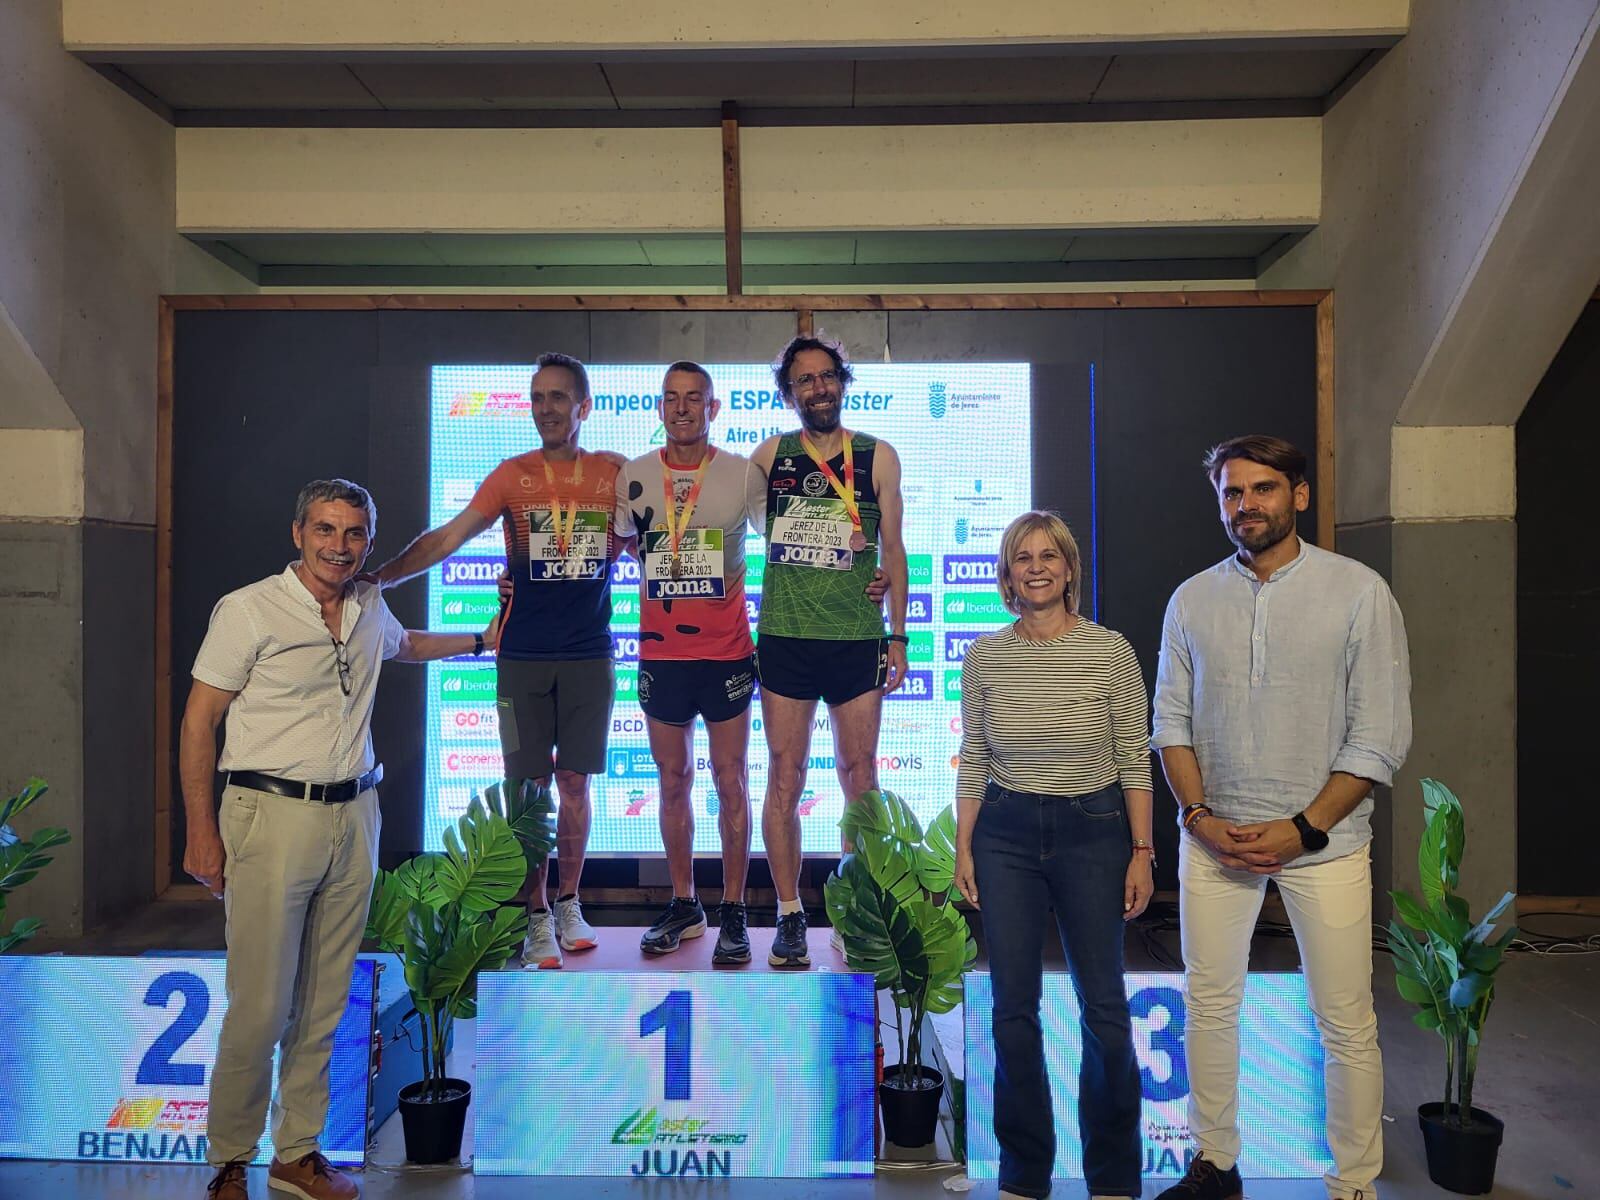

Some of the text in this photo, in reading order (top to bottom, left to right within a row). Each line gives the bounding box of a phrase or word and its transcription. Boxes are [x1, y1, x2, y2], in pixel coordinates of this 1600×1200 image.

[730, 390, 784, 410] ESPA
[727, 427, 758, 443] Aire
[790, 521, 838, 534] JEREZ DE LA
[573, 534, 583, 545] DE
[783, 532, 842, 547] FRONTERA 2023
[585, 546, 599, 556] 2023
[660, 553, 707, 564] JERZ DE LA
[613, 562, 639, 582] Jo
[696, 565, 712, 576] 2023
[966, 602, 1005, 613] Iberdro
[615, 639, 639, 659] Jo
[135, 971, 210, 1085] 2
[640, 990, 692, 1100] 1
[1128, 987, 1189, 1101] 3
[631, 1149, 731, 1176] JUAN
